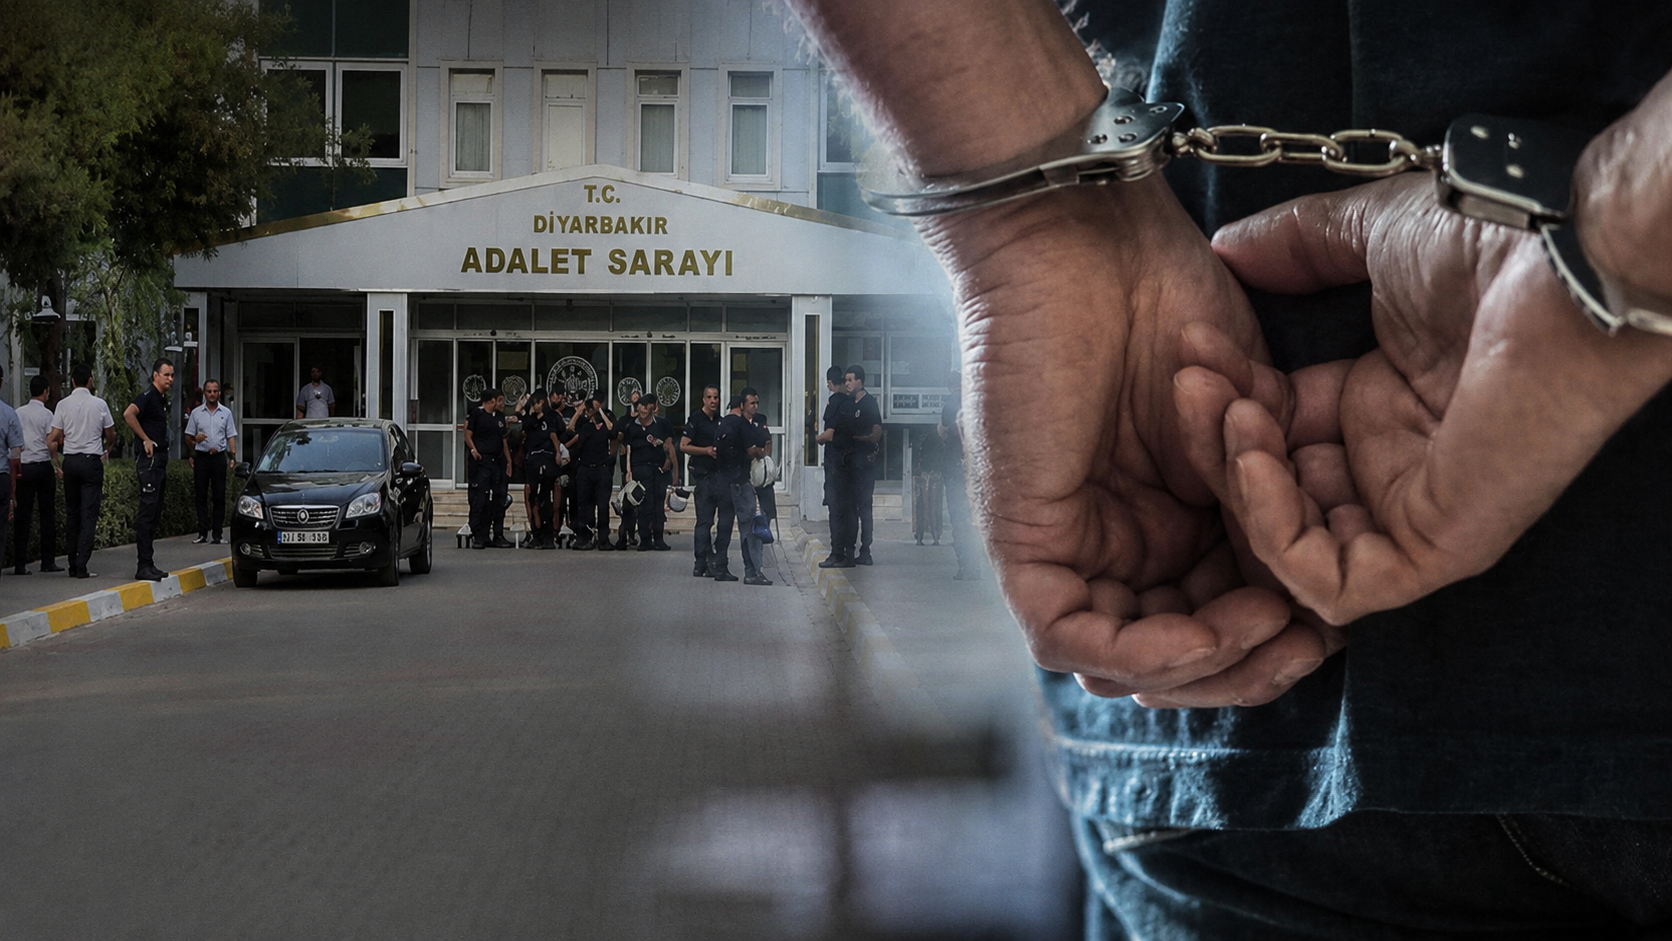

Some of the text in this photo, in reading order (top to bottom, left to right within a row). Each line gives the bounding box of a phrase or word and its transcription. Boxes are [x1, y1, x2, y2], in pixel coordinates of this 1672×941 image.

[583, 184, 621, 204] T.C.
[533, 211, 668, 235] DİYARBAKIR
[461, 246, 733, 277] ADALET SARAYI
